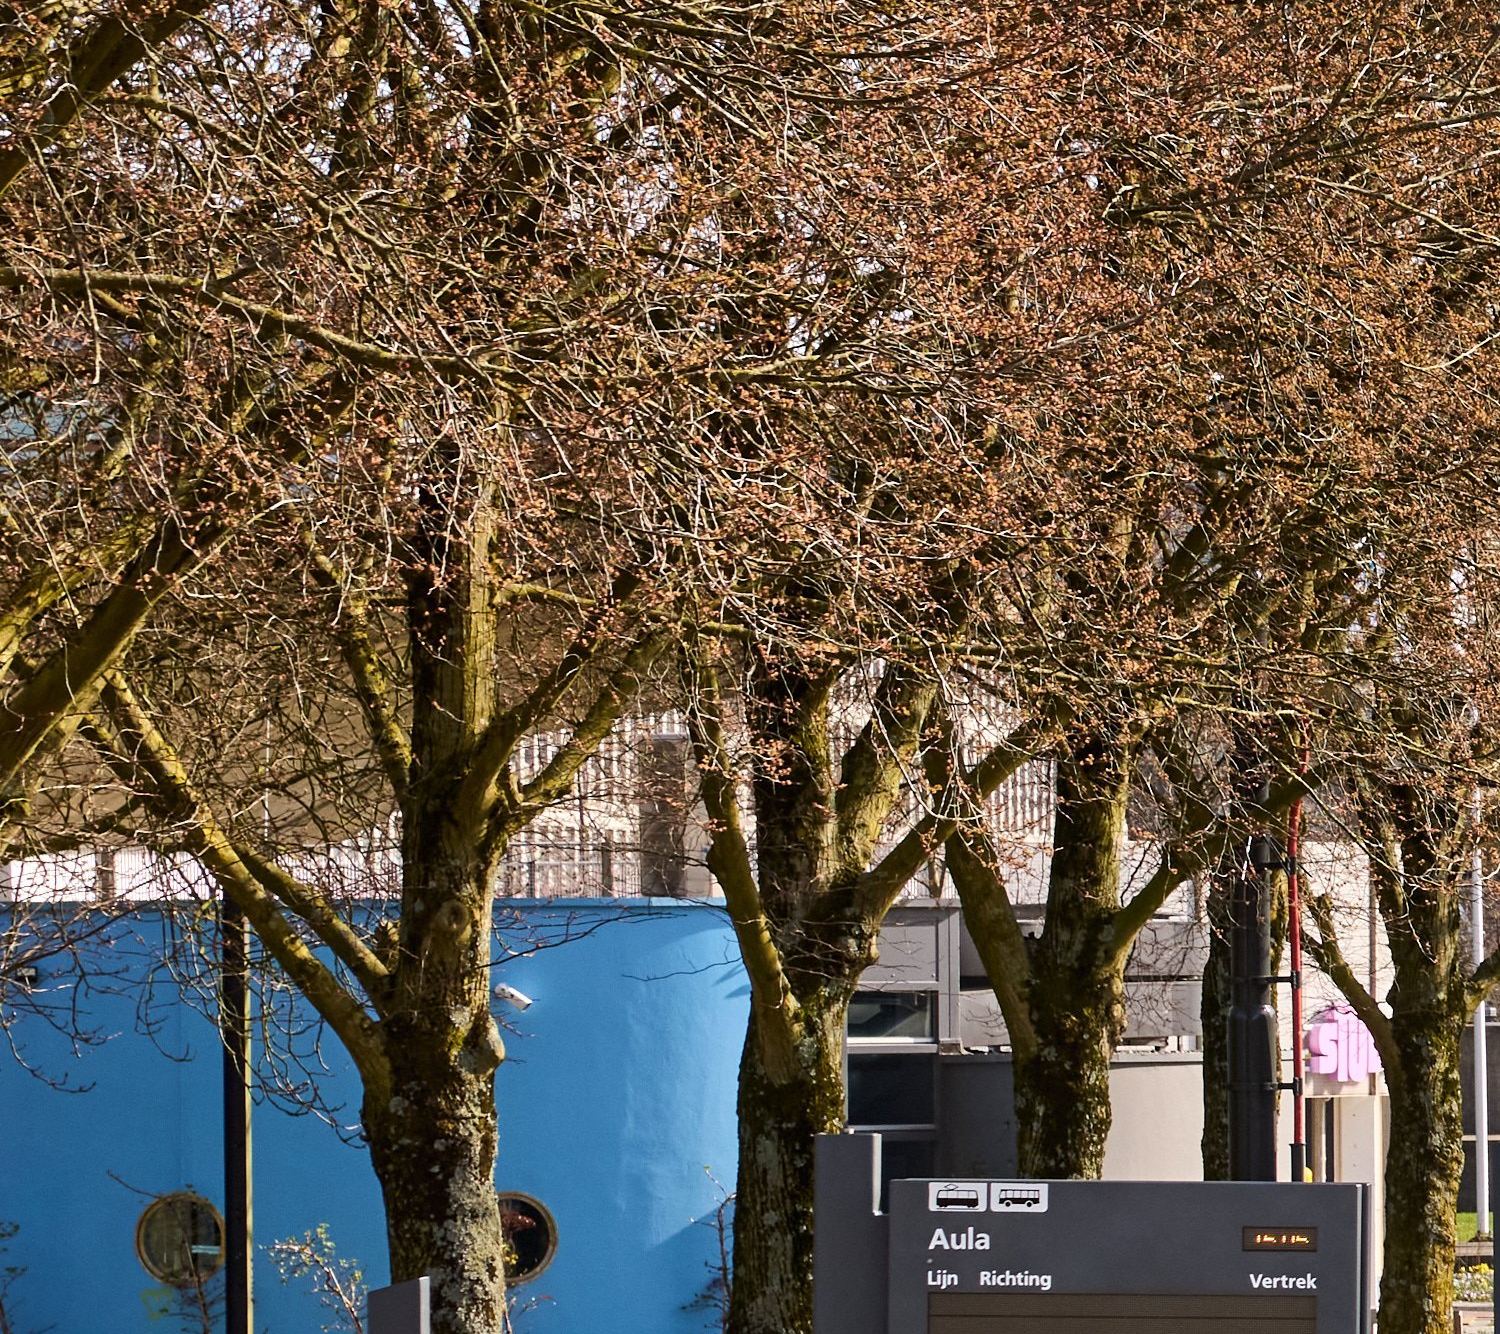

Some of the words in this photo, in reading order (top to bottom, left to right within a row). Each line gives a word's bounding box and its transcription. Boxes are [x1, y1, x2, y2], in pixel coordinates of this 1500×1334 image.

[929, 1226, 991, 1251] Aula
[927, 1270, 959, 1290] Lijn
[979, 1269, 1052, 1291] Richting
[1249, 1272, 1318, 1290] Vertrek
